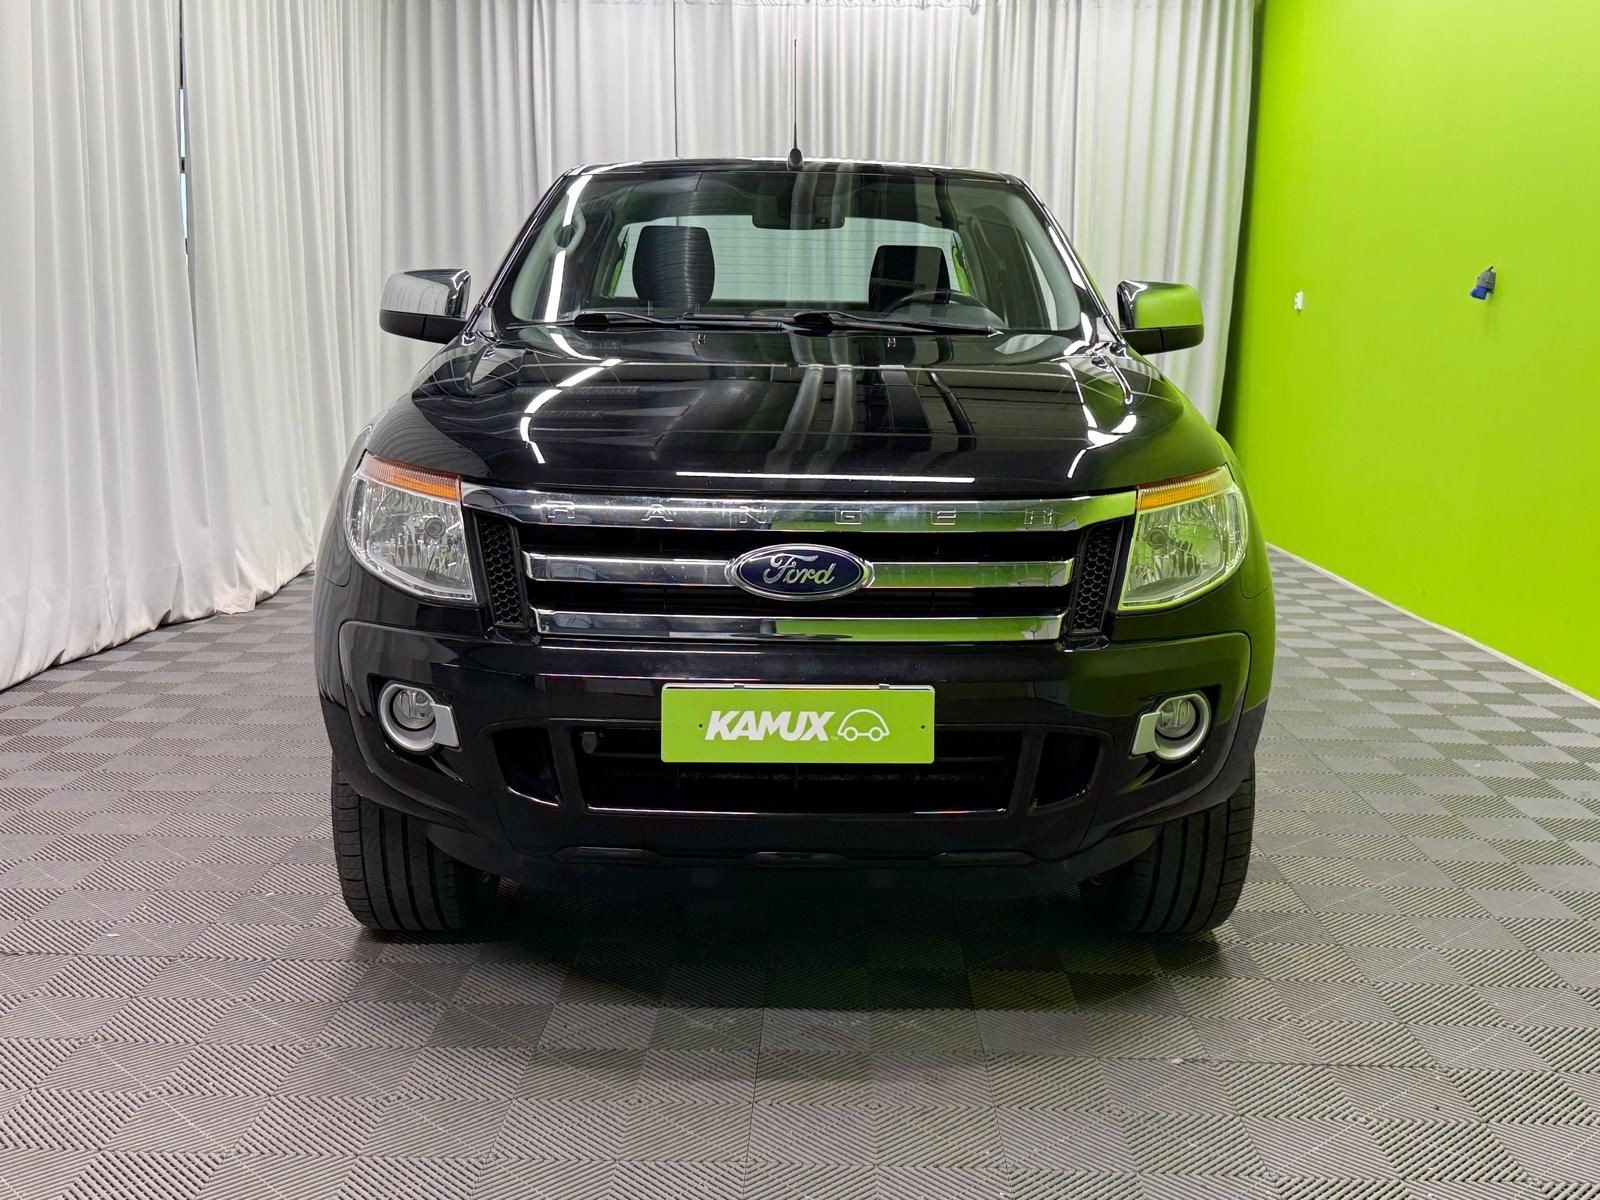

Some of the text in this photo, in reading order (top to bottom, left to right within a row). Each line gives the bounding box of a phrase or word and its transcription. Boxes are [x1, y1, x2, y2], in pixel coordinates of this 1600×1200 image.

[541, 500, 1054, 525] RANGER
[763, 553, 837, 585] Ford
[704, 710, 835, 741] KAMUX
